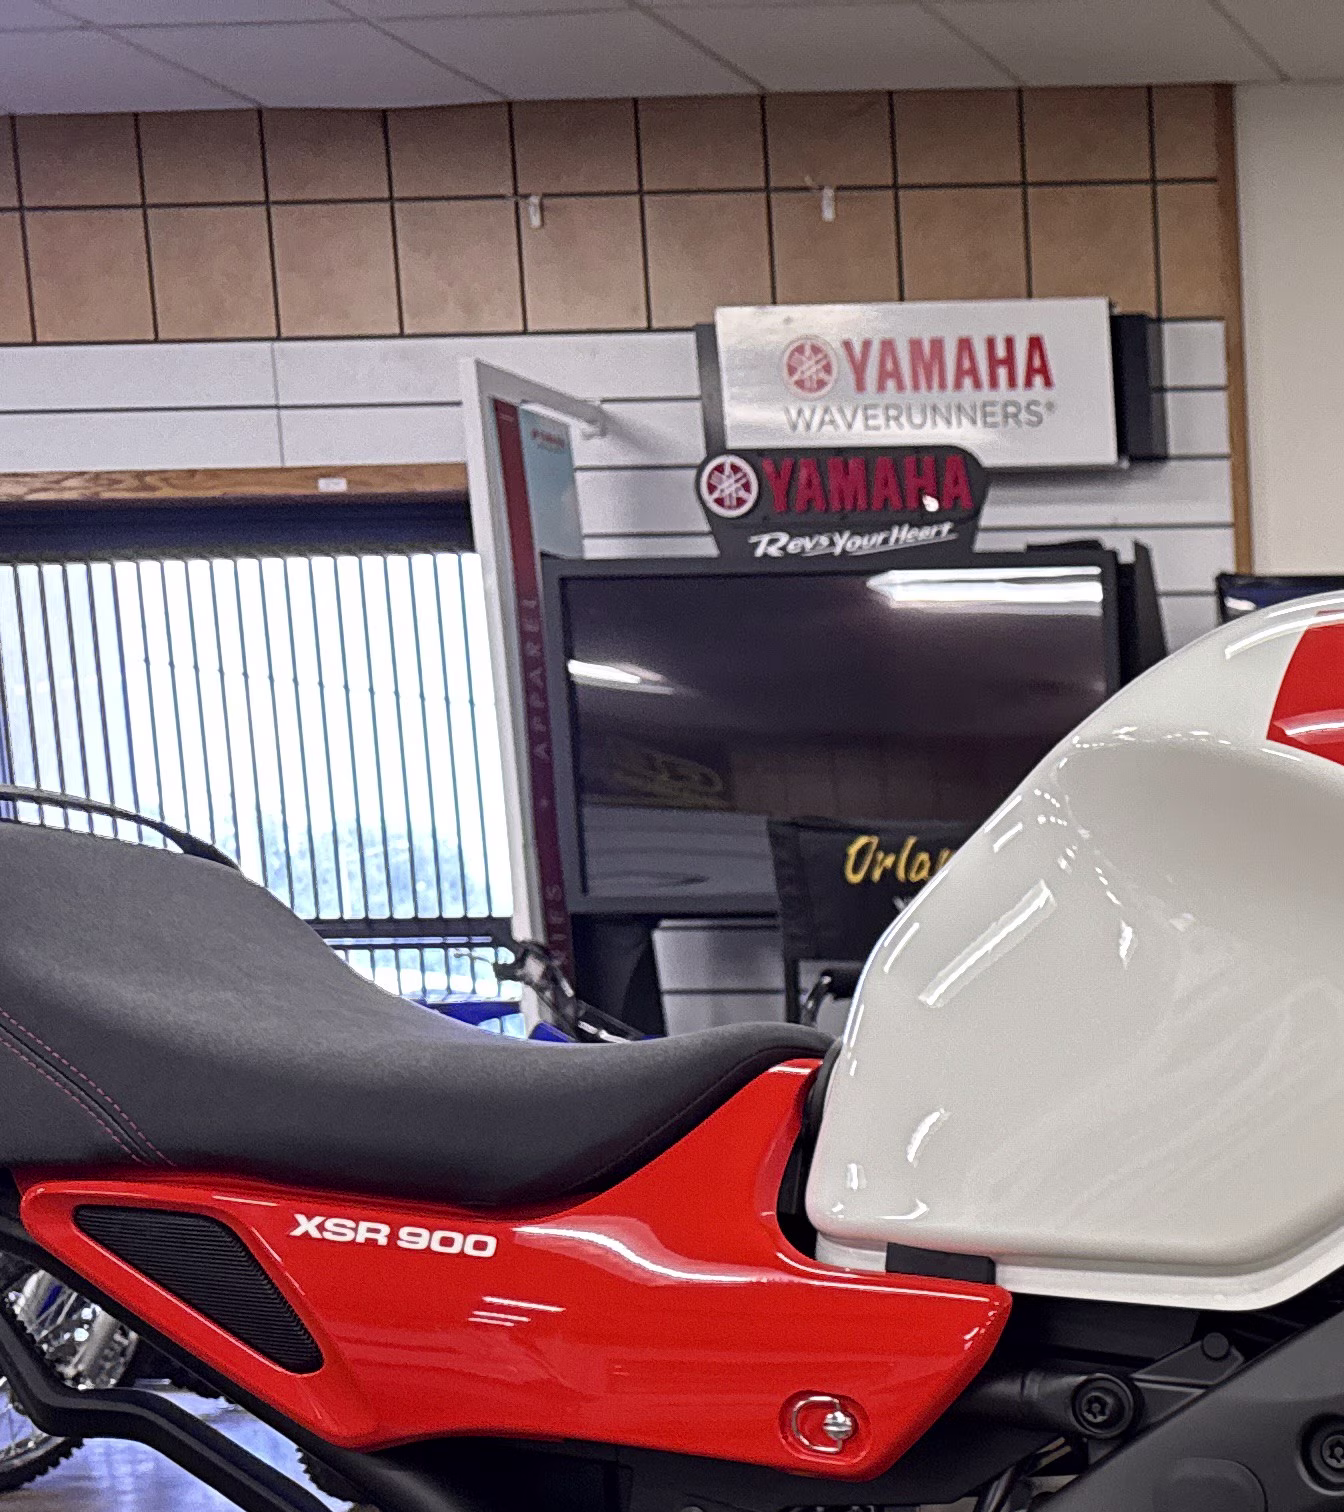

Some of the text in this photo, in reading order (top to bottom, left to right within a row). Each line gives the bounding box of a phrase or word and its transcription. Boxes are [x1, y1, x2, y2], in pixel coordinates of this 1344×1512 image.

[842, 335, 1055, 393] YAMAHA
[762, 454, 973, 513] YAMAHA
[289, 1213, 498, 1258] XSR 900
